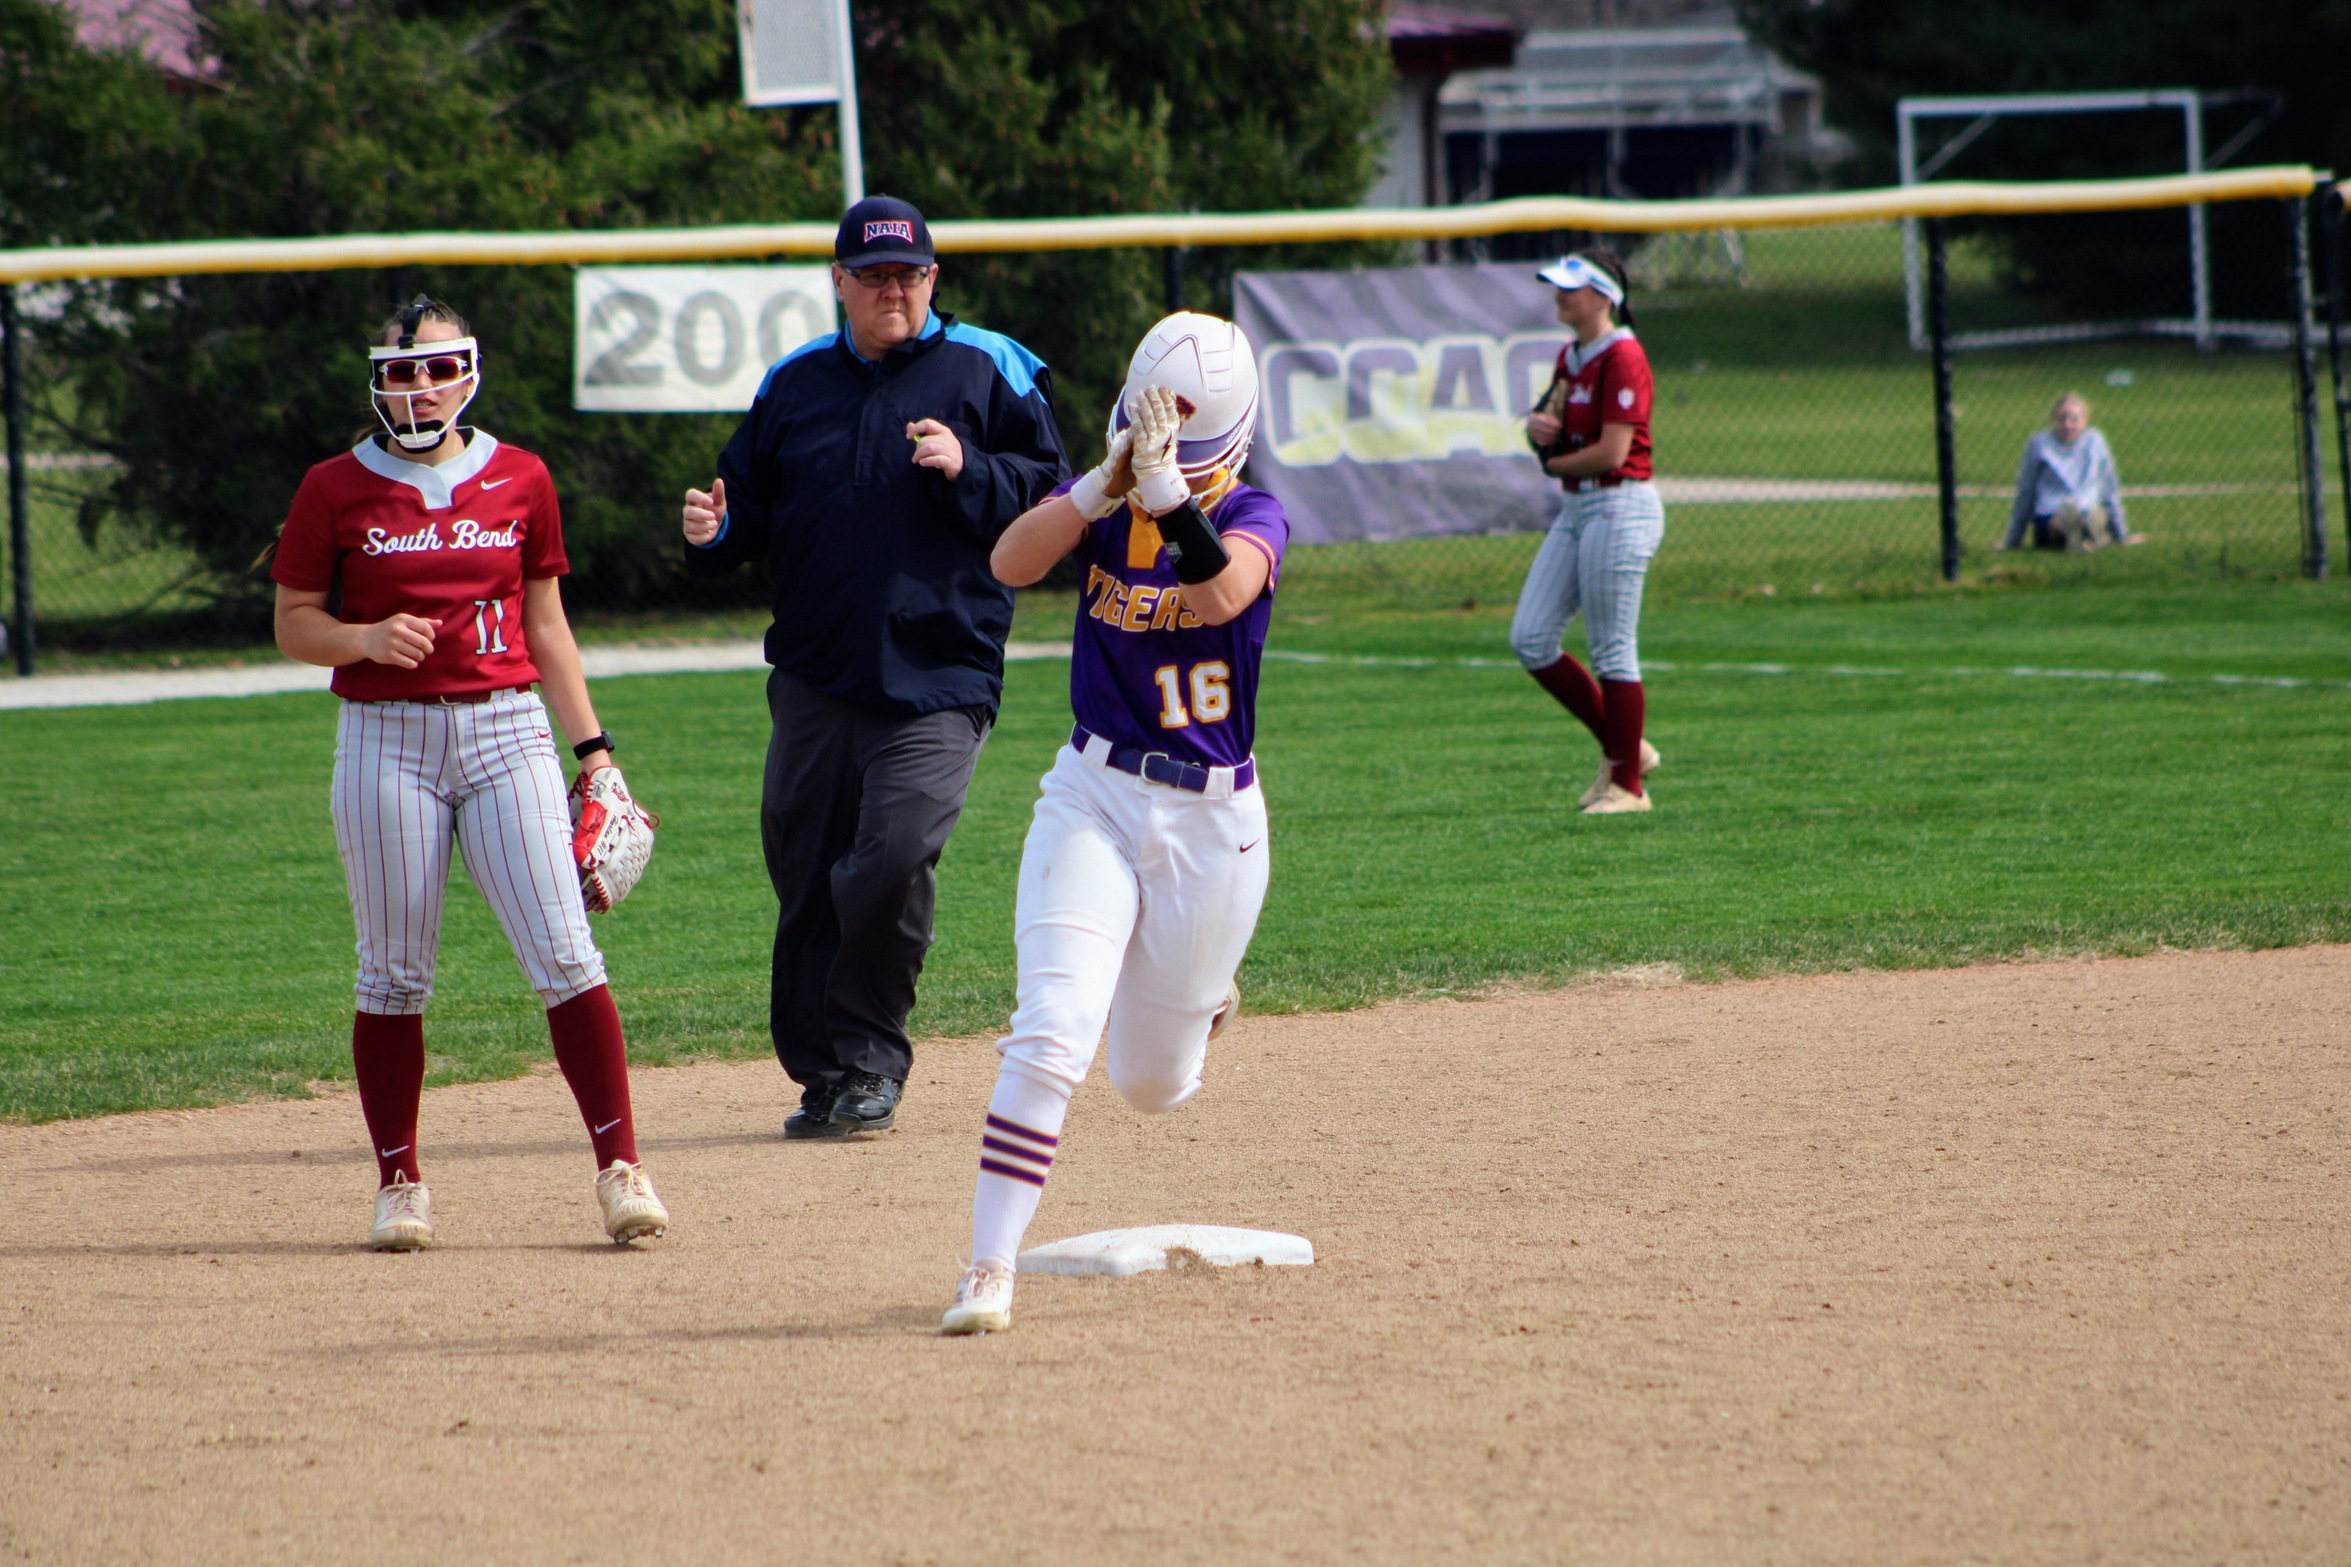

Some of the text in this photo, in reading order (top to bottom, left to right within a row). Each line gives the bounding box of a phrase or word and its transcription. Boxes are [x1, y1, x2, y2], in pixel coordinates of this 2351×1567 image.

[864, 220, 913, 243] NAIA
[363, 519, 518, 556] South Bend
[475, 599, 508, 654] 11
[1154, 660, 1230, 729] 16
